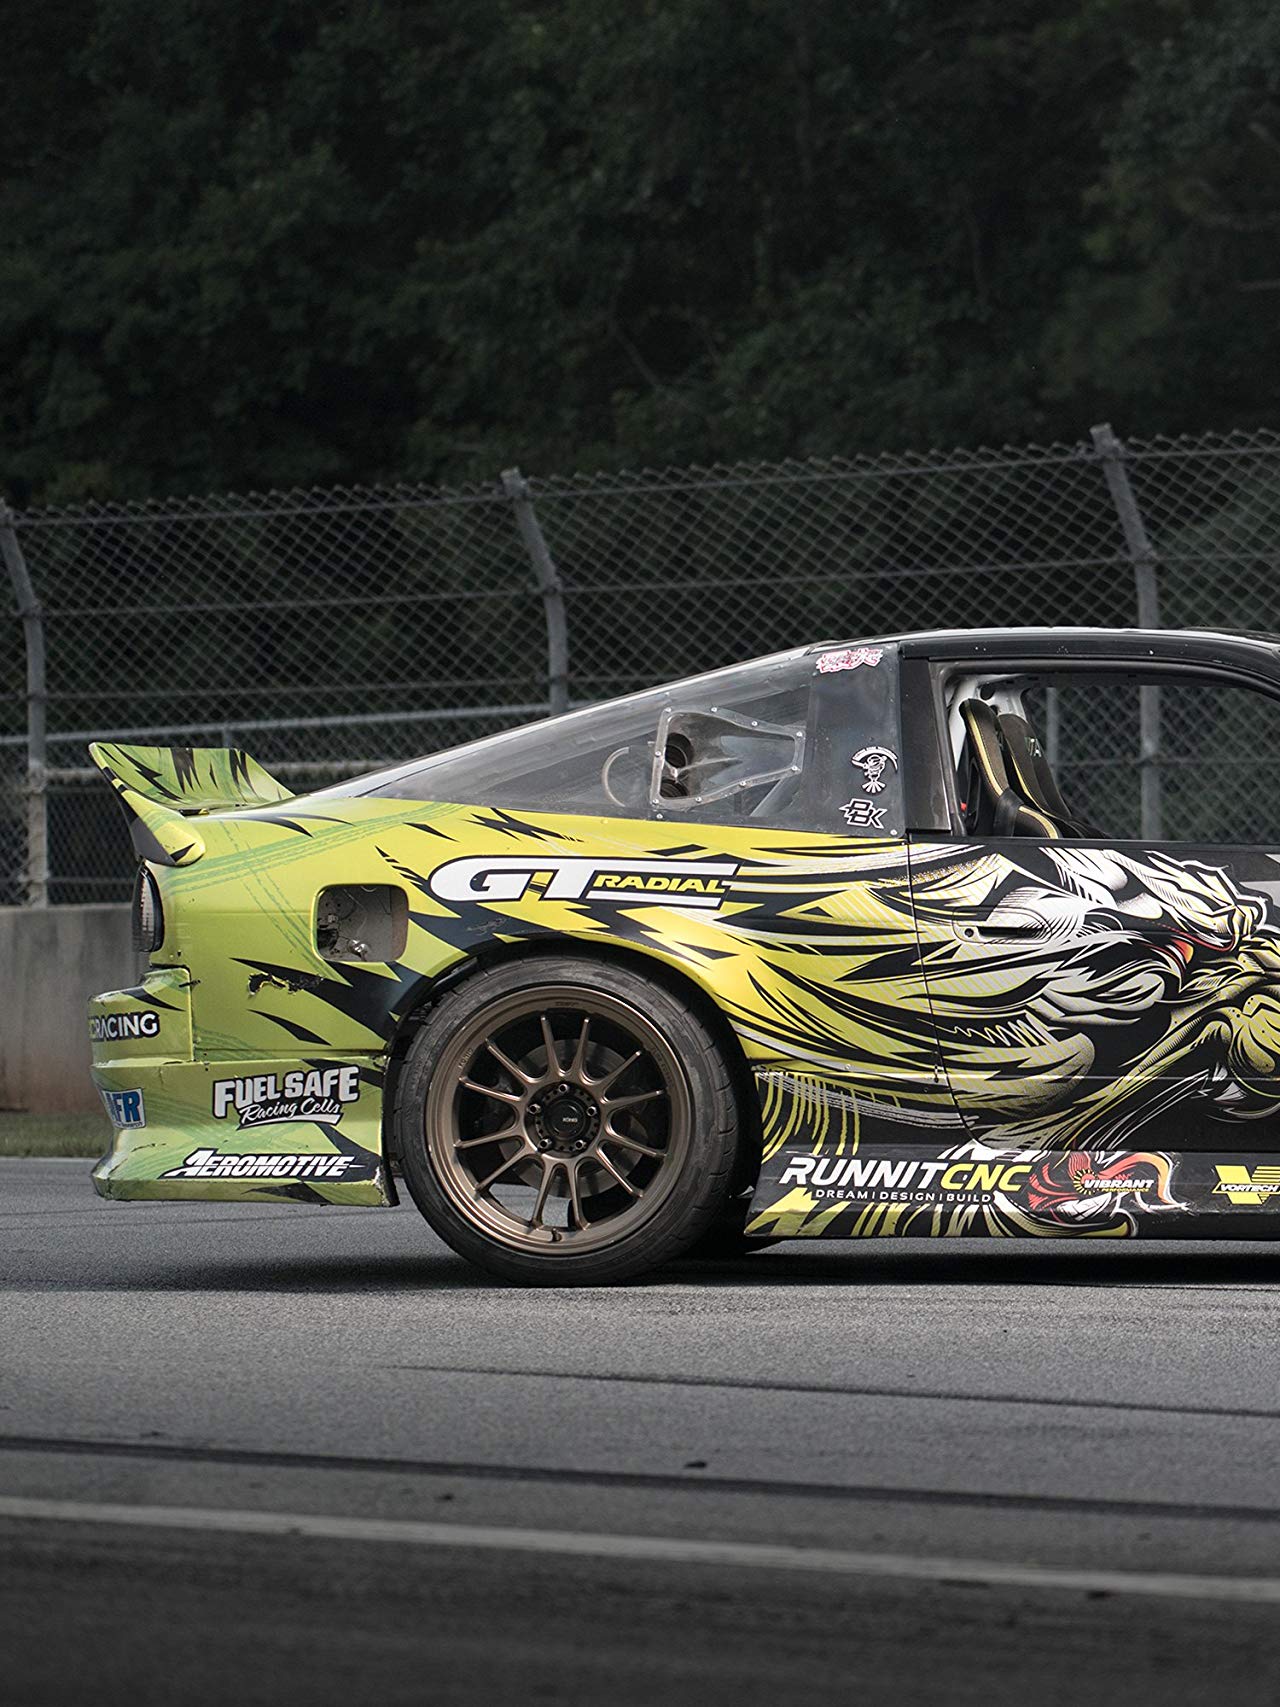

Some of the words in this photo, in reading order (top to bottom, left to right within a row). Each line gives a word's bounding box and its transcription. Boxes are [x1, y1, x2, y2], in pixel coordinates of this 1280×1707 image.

[594, 874, 730, 894] RADIAL
[214, 1075, 281, 1118] FUEL
[284, 1066, 359, 1102] SAFE
[239, 1102, 298, 1124] Racing
[300, 1097, 340, 1115] Cells
[164, 1149, 356, 1177] AEROMOTIVE
[1083, 1179, 1155, 1189] VIBRANT
[1220, 1184, 1280, 1192] VORTECH
[815, 1188, 868, 1200] DREAM
[879, 1190, 936, 1202] DESIGN
[946, 1192, 992, 1203] BUILD
